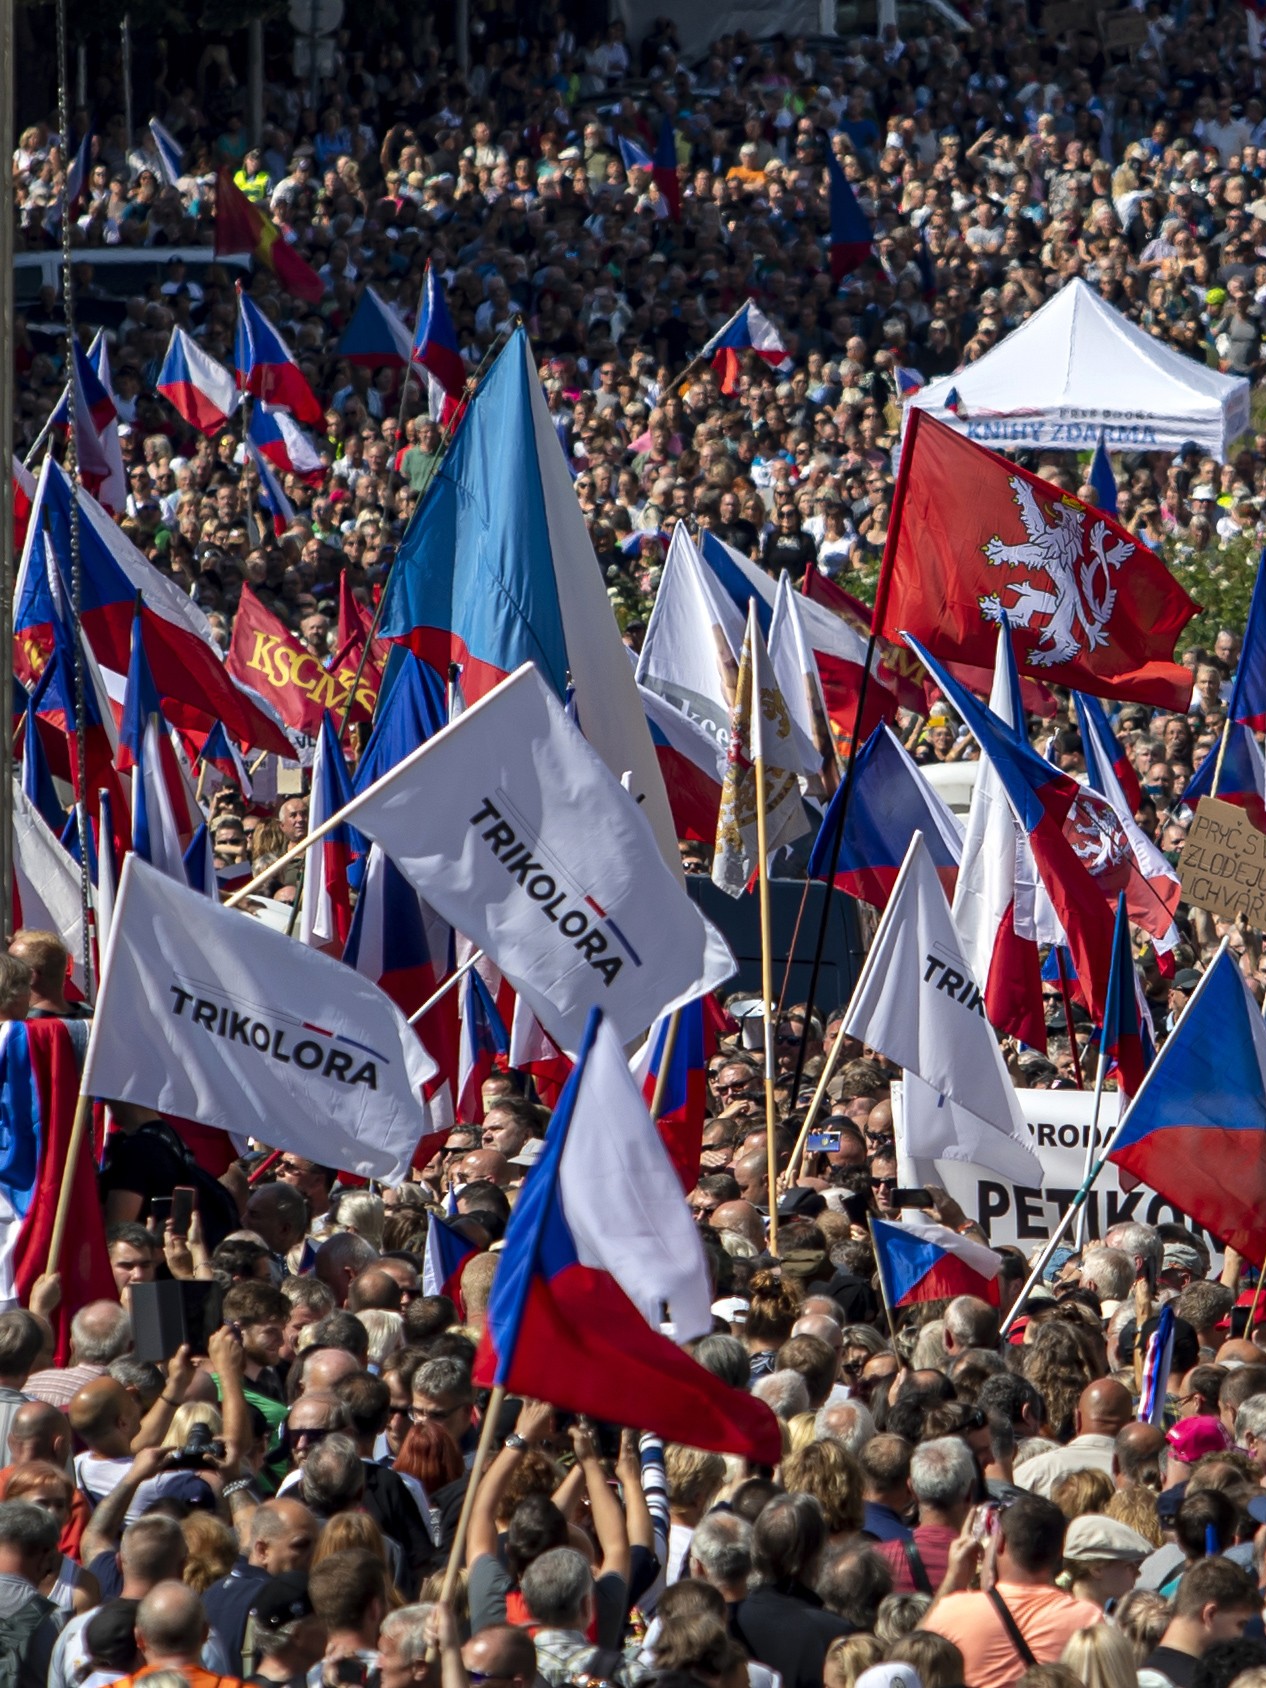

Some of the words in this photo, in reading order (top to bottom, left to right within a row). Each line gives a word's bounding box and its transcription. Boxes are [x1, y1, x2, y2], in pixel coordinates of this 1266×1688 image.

[967, 421, 1045, 441] KNIHY
[1051, 422, 1157, 444] ZDARMA
[1193, 816, 1243, 851] PRYČ
[1243, 834, 1260, 855] S
[469, 797, 624, 987] TRIKOLORA
[170, 985, 378, 1091] TRIKOLORA
